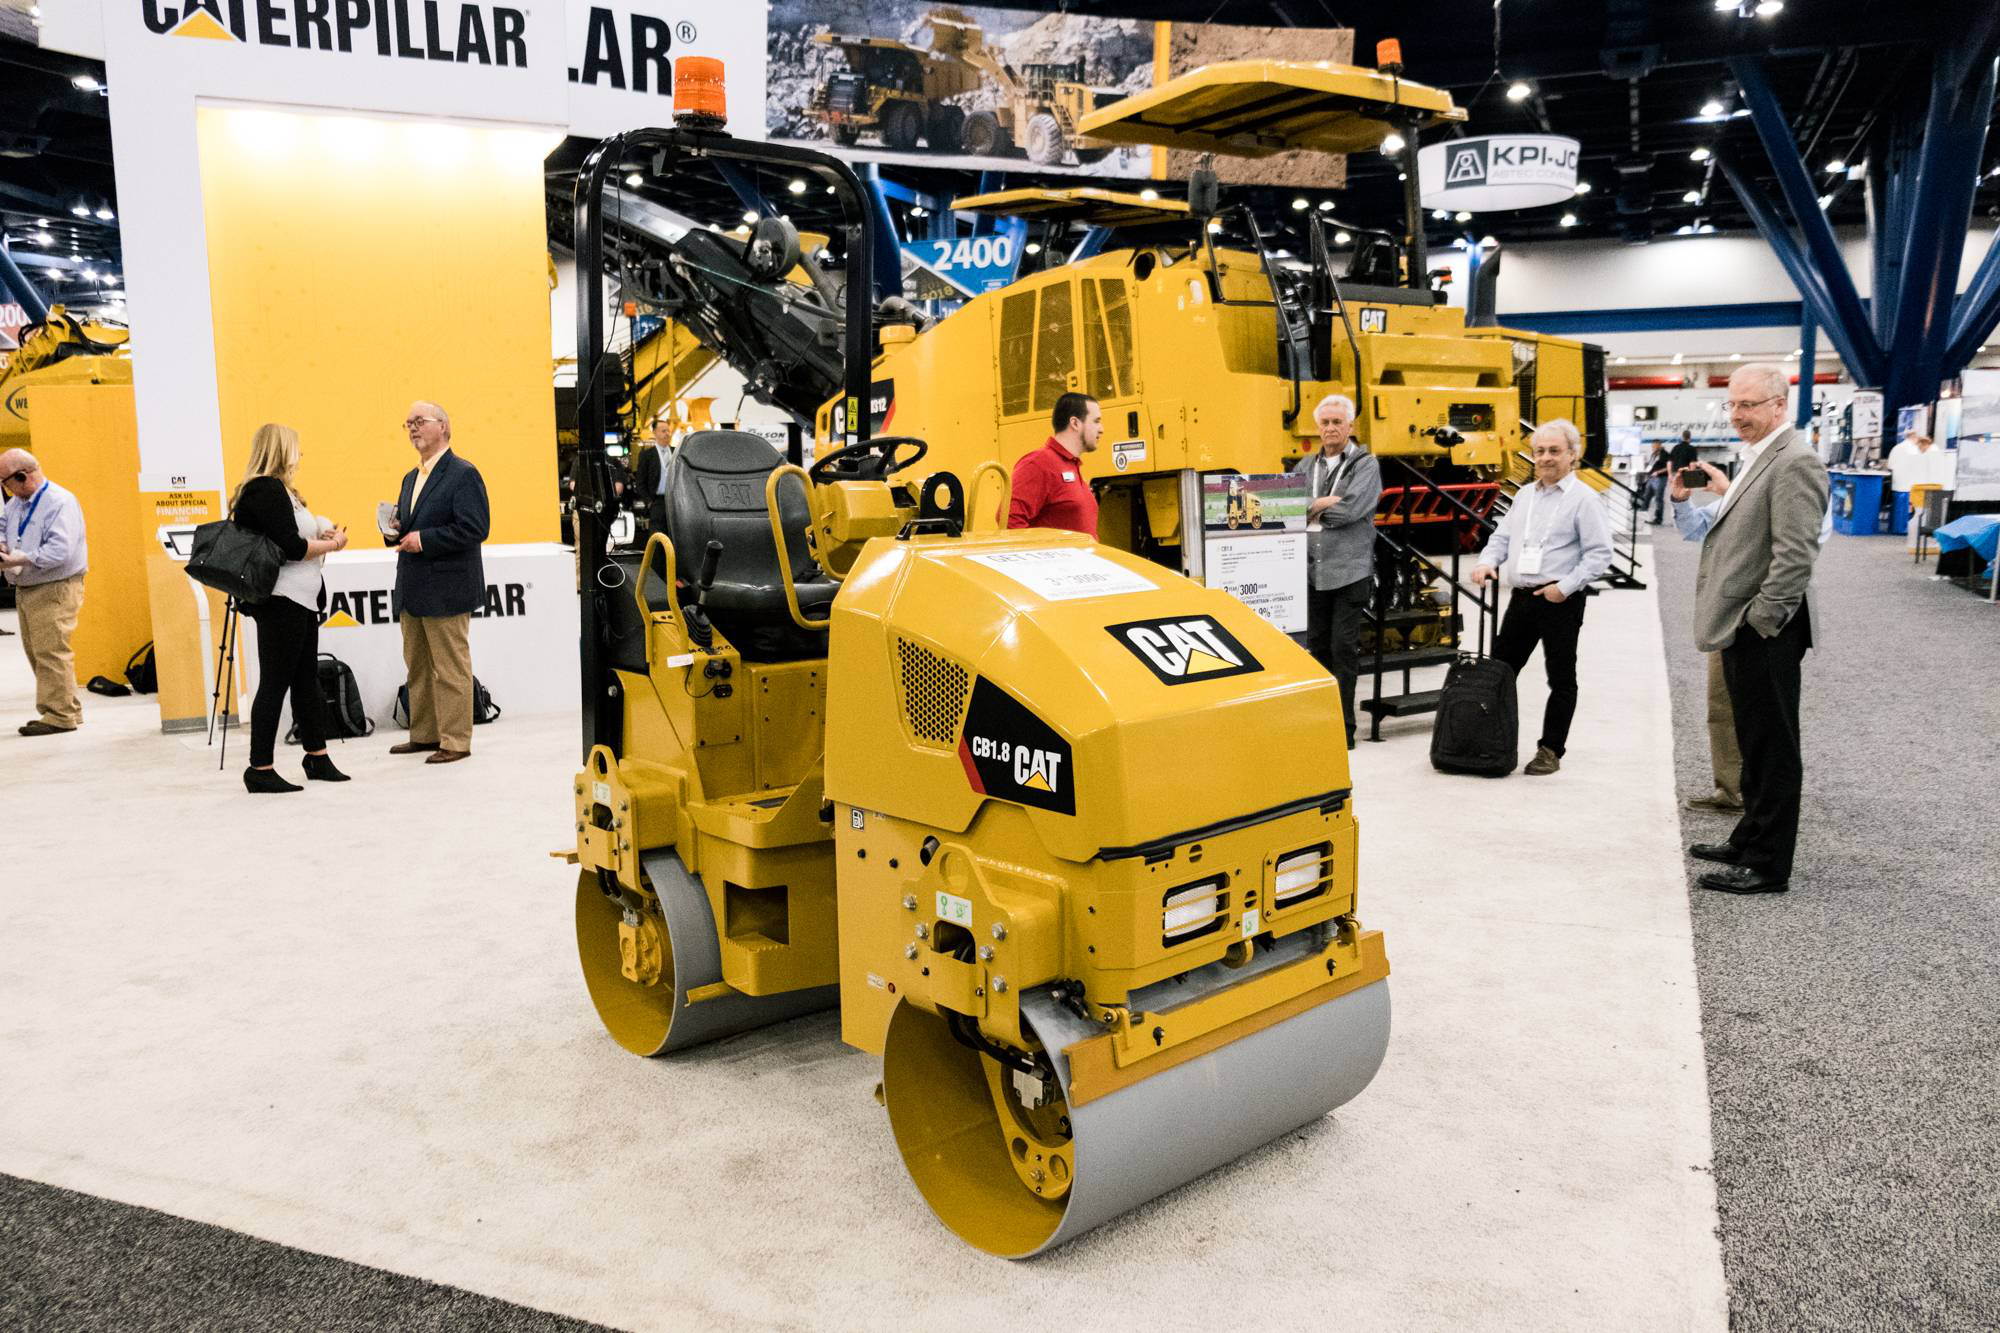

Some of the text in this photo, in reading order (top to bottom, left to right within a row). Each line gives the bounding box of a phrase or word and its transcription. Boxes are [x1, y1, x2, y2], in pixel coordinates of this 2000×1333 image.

[933, 237, 1012, 270] 2400
[1361, 309, 1386, 333] CAT
[171, 476, 186, 485] CAT
[717, 483, 752, 506] CAT
[1240, 583, 1258, 596] 3000
[1126, 620, 1244, 676] CAT
[972, 735, 1062, 793] CB1.8 CAT
